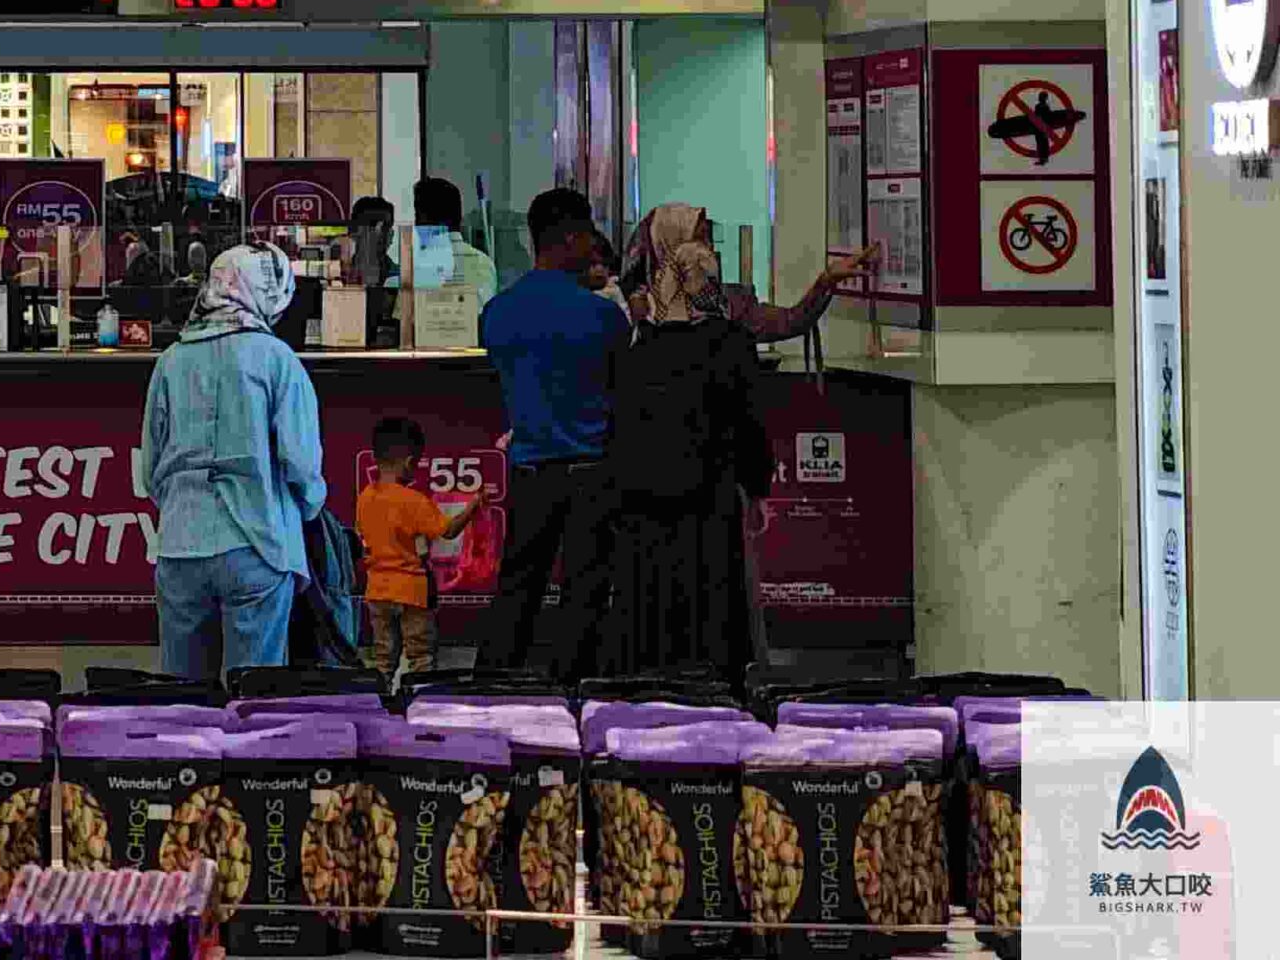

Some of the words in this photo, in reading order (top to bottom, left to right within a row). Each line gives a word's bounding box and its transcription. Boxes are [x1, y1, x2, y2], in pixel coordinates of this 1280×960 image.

[280, 199, 314, 212] 160
[799, 460, 843, 470] KLIA
[430, 458, 483, 492] 55
[108, 776, 173, 790] Wonderful
[242, 778, 308, 790] Wonderful
[400, 775, 464, 794] Wonderful
[671, 781, 733, 795] Wonderful
[792, 780, 859, 794] Wonderful
[693, 803, 721, 918] PISTACHIOS
[817, 803, 840, 920] PISTACHIOS
